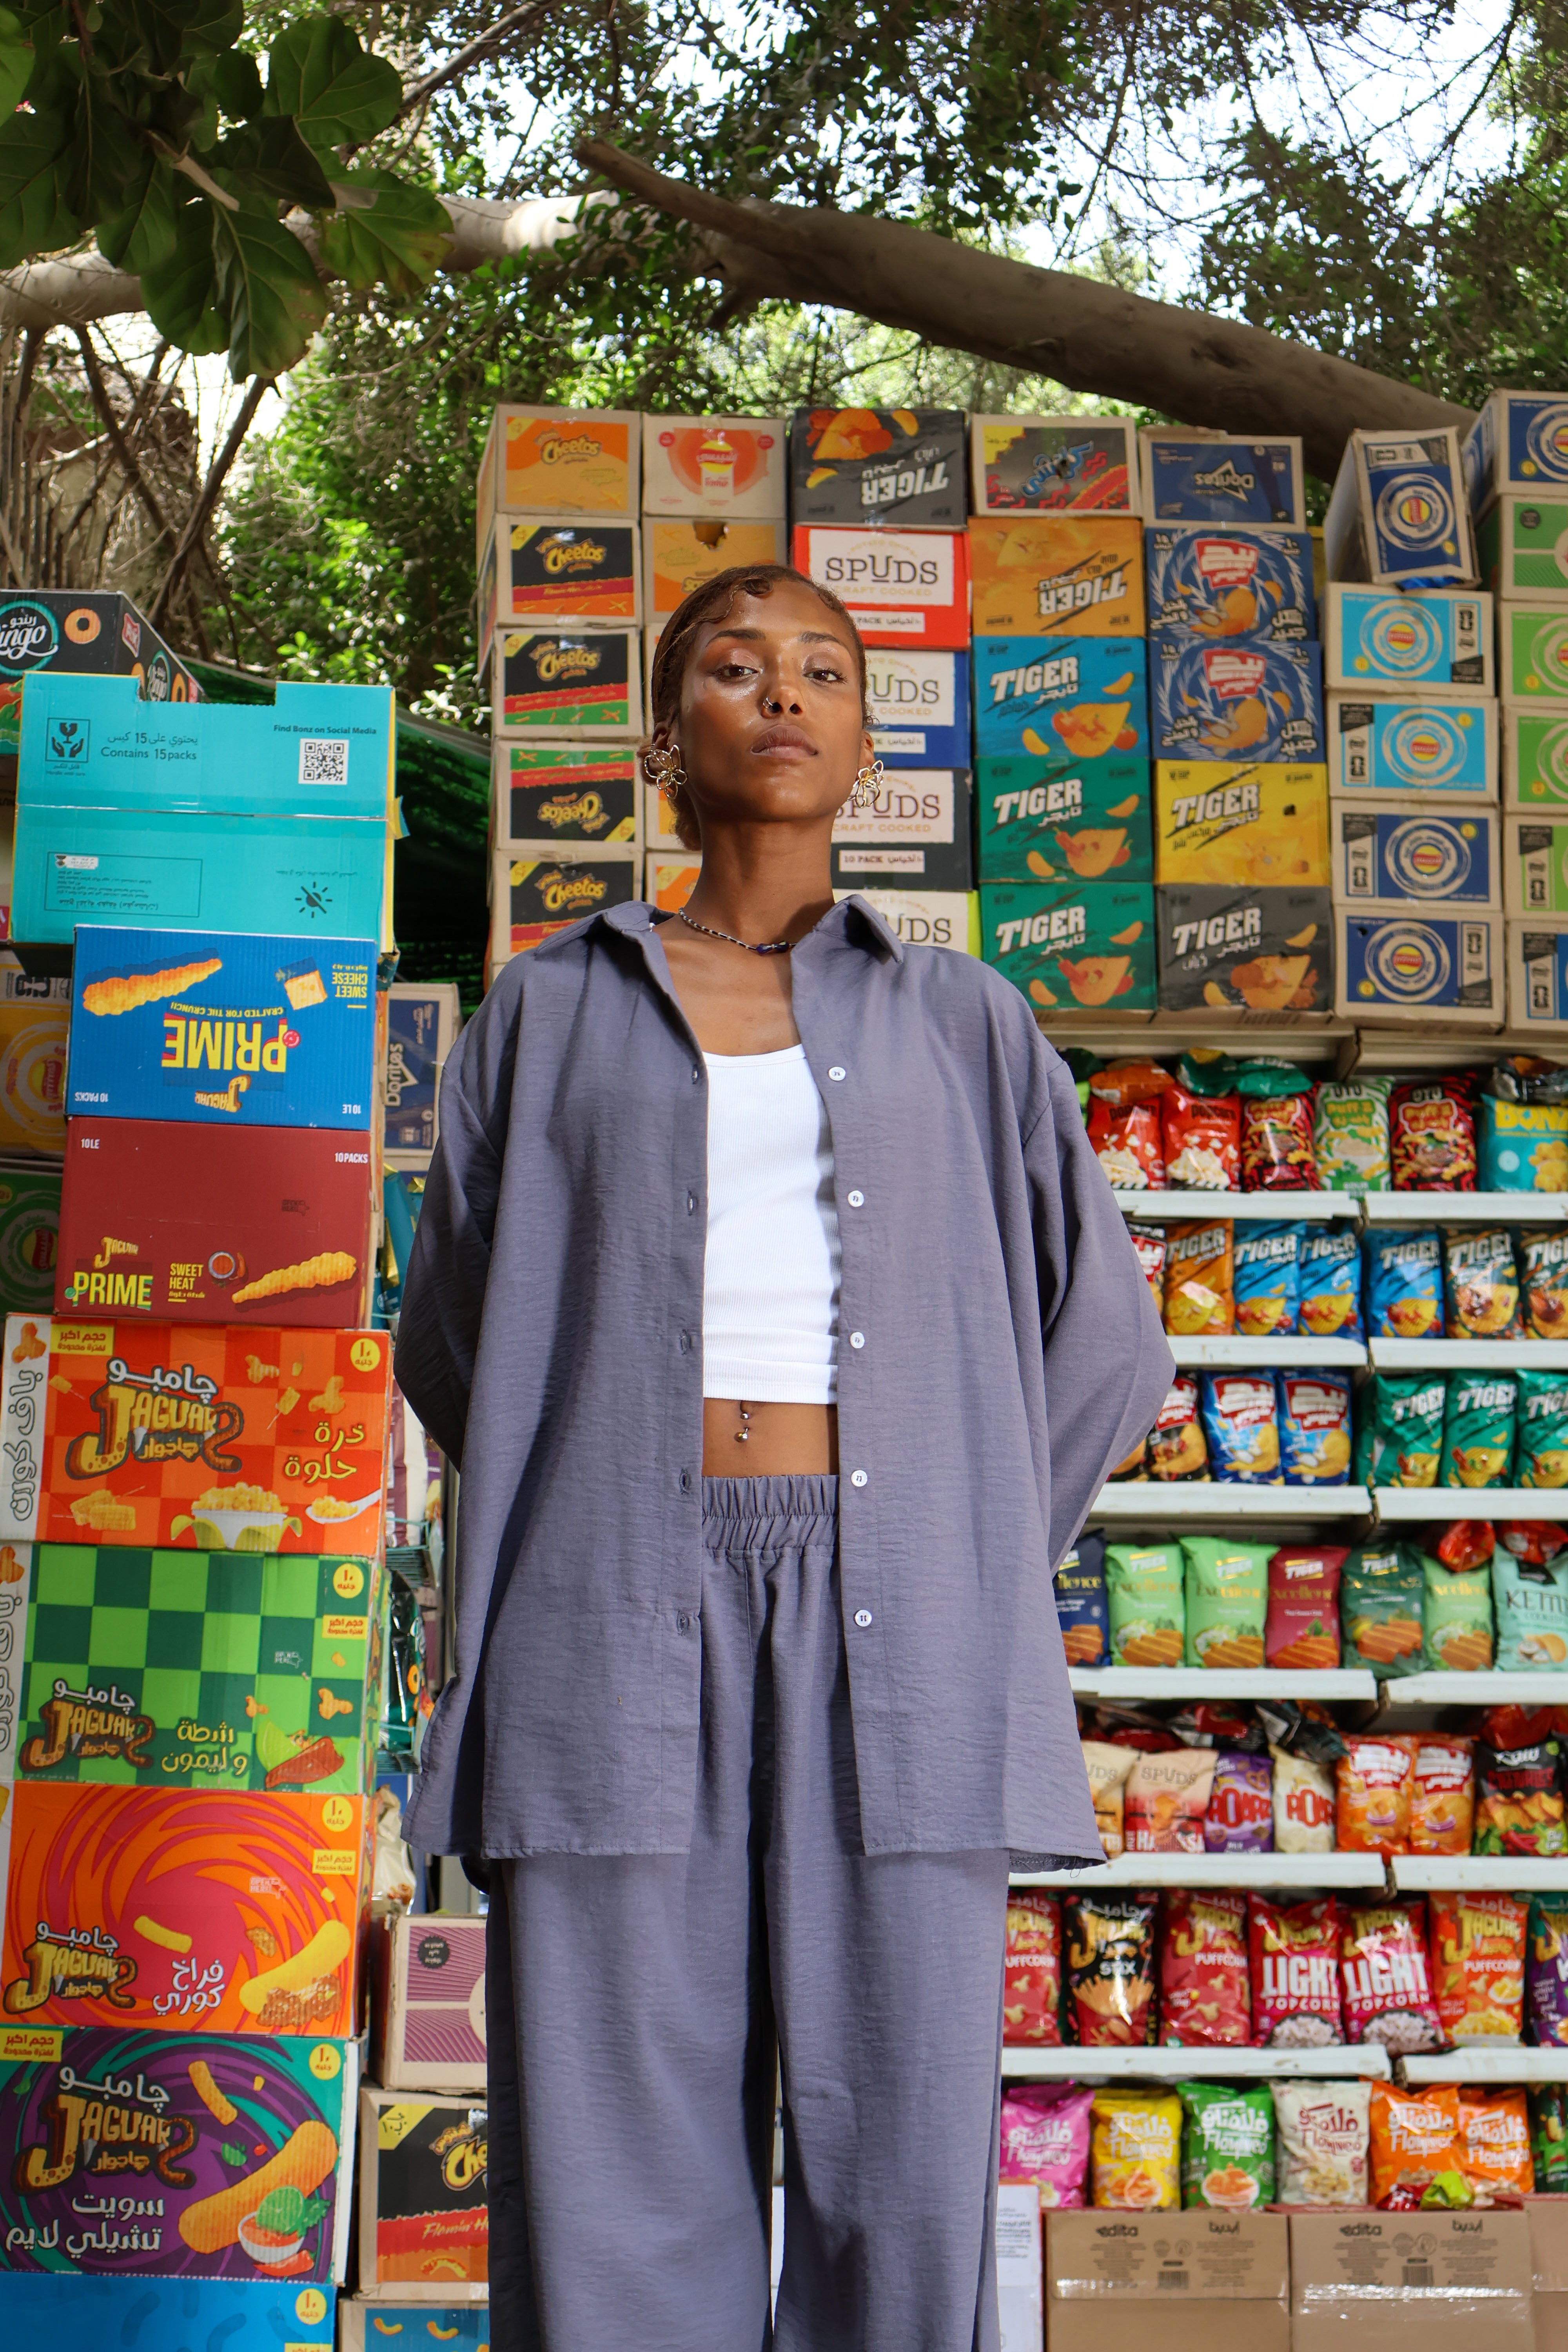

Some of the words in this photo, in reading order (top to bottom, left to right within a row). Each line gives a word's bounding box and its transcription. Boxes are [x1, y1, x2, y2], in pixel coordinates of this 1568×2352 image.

[541, 433, 601, 466] Cheetos
[862, 461, 950, 506] TIGER
[543, 538, 606, 574] Cheetos
[826, 554, 938, 584] SPUDS
[880, 588, 932, 596] COOKED
[1039, 571, 1127, 616] TIGER
[0, 624, 48, 660] ingo
[537, 645, 601, 681] Cheetos
[870, 673, 939, 702] UDS
[991, 656, 1078, 702] TIGER
[1035, 684, 1078, 705] تايجر
[880, 707, 932, 716] COOKED
[107, 732, 131, 742] كيس
[135, 733, 147, 744] 15
[149, 734, 165, 744] على
[169, 734, 198, 747] يحتوي
[101, 747, 149, 757] Contains
[155, 749, 166, 759] 15
[168, 749, 196, 761] packs
[538, 791, 602, 828] Cheetos
[994, 778, 1083, 825] TIGER
[1172, 784, 1259, 829] TIGER
[1039, 807, 1082, 827] تايجر
[1215, 811, 1259, 831] تايجر
[878, 824, 931, 833] COOKED
[543, 875, 607, 911] Cheetos
[890, 917, 951, 943] UDS
[996, 905, 1086, 953] TIGER
[1172, 907, 1262, 956] TIGER
[1041, 933, 1086, 956] تايجر
[1217, 935, 1261, 958] تايجر
[332, 972, 368, 985] CHEESE
[335, 985, 367, 999] SWEET
[171, 1002, 205, 1015] CRUNCH
[207, 1008, 223, 1017] THE
[225, 1009, 243, 1018] FOR
[244, 1007, 283, 1018] CRAFTED
[162, 1018, 288, 1073] PRIME
[387, 1044, 404, 1107] Doritos
[74, 1091, 96, 1102] PACKS
[98, 1092, 109, 1102] 10
[342, 1104, 352, 1114] LE
[353, 1104, 361, 1114] 10
[81, 1138, 91, 1149] 10
[91, 1139, 100, 1149] LE
[335, 1152, 343, 1163] 10
[343, 1153, 368, 1164] PACKS
[1166, 1227, 1225, 1263] TIGER
[1234, 1234, 1297, 1265] TIGER
[170, 1262, 204, 1277] SWEET
[72, 1271, 153, 1311] PRIME
[169, 1277, 195, 1290] HEAT
[82, 1332, 106, 1343] حجم
[355, 1357, 374, 1367] جنيه
[8, 1370, 43, 1436] باف
[74, 1384, 218, 1476] JAGUAR
[315, 1420, 365, 1453] ذرة
[284, 1453, 358, 1485] حلوة
[1131, 1555, 1166, 1572] TIGER
[1216, 1559, 1252, 1579] TIGER
[1285, 1561, 1323, 1579] TIGER
[27, 1700, 136, 1770] JAGUAR
[1142, 1766, 1198, 1786] SPUDS
[1005, 1955, 1055, 1968] UFFCORN
[1463, 1959, 1521, 1973] PUFFCORN
[14, 1940, 118, 2011] JAGUAR
[172, 1957, 225, 1991] فراخ
[1343, 1952, 1428, 2000] LIGHT
[153, 1984, 226, 2016] كوري
[1266, 1998, 1340, 2011] POPCORN
[1351, 1994, 1429, 2012] POPCORN
[30, 2035, 54, 2046] حجم
[26, 2094, 171, 2189] JAGUAR
[72, 2195, 165, 2218] سويت
[6, 2221, 60, 2251] لايم
[1096, 2224, 1138, 2238] edita
[1339, 2222, 1382, 2236] edita
[66, 2224, 162, 2259] تشيلي
